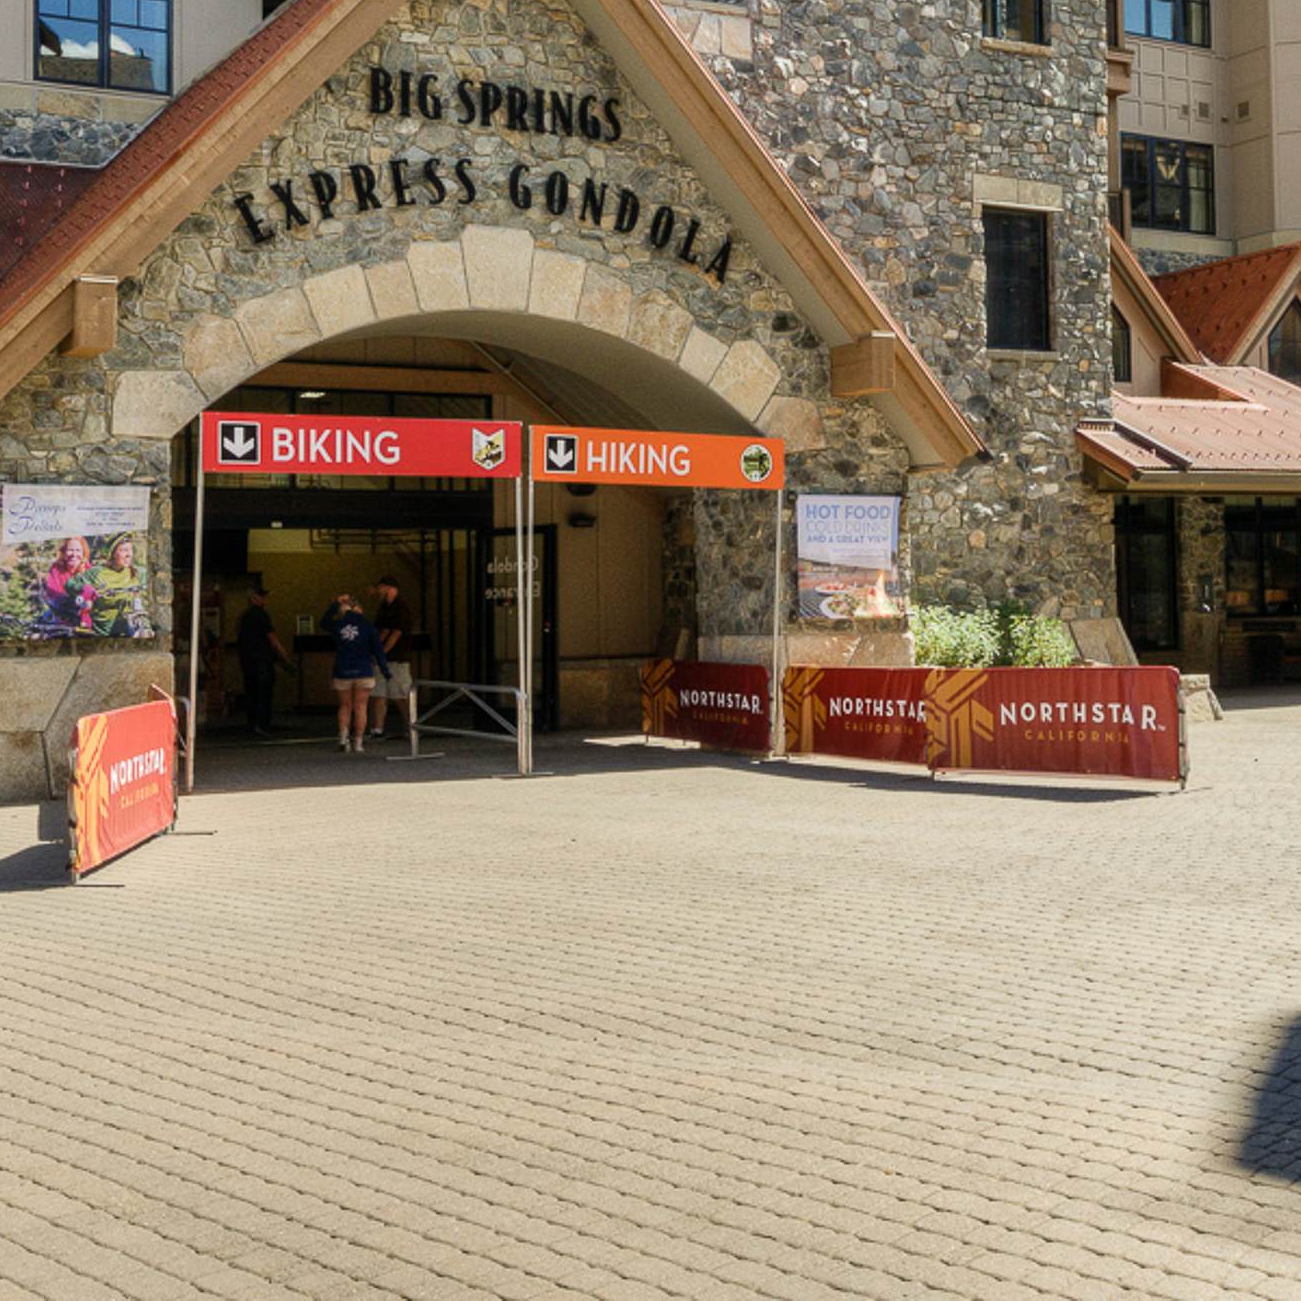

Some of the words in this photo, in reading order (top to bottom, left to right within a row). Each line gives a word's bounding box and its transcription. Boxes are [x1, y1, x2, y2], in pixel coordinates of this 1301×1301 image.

[368, 66, 442, 120] BIG
[457, 78, 622, 142] SPRINGS
[235, 158, 475, 244] EXPRESS
[508, 164, 734, 283] GONDOLA
[272, 427, 400, 465] BIKING
[587, 440, 690, 476] HIKING
[806, 504, 840, 519] HOT
[844, 504, 890, 520] FOOD
[680, 688, 761, 714] NORTHSTAR
[830, 698, 926, 723] NORTHSTAR
[1000, 702, 1157, 731] NORTHSTAR
[1024, 730, 1129, 743] CALIFORNIA
[110, 747, 165, 795] NORTHSTAR
